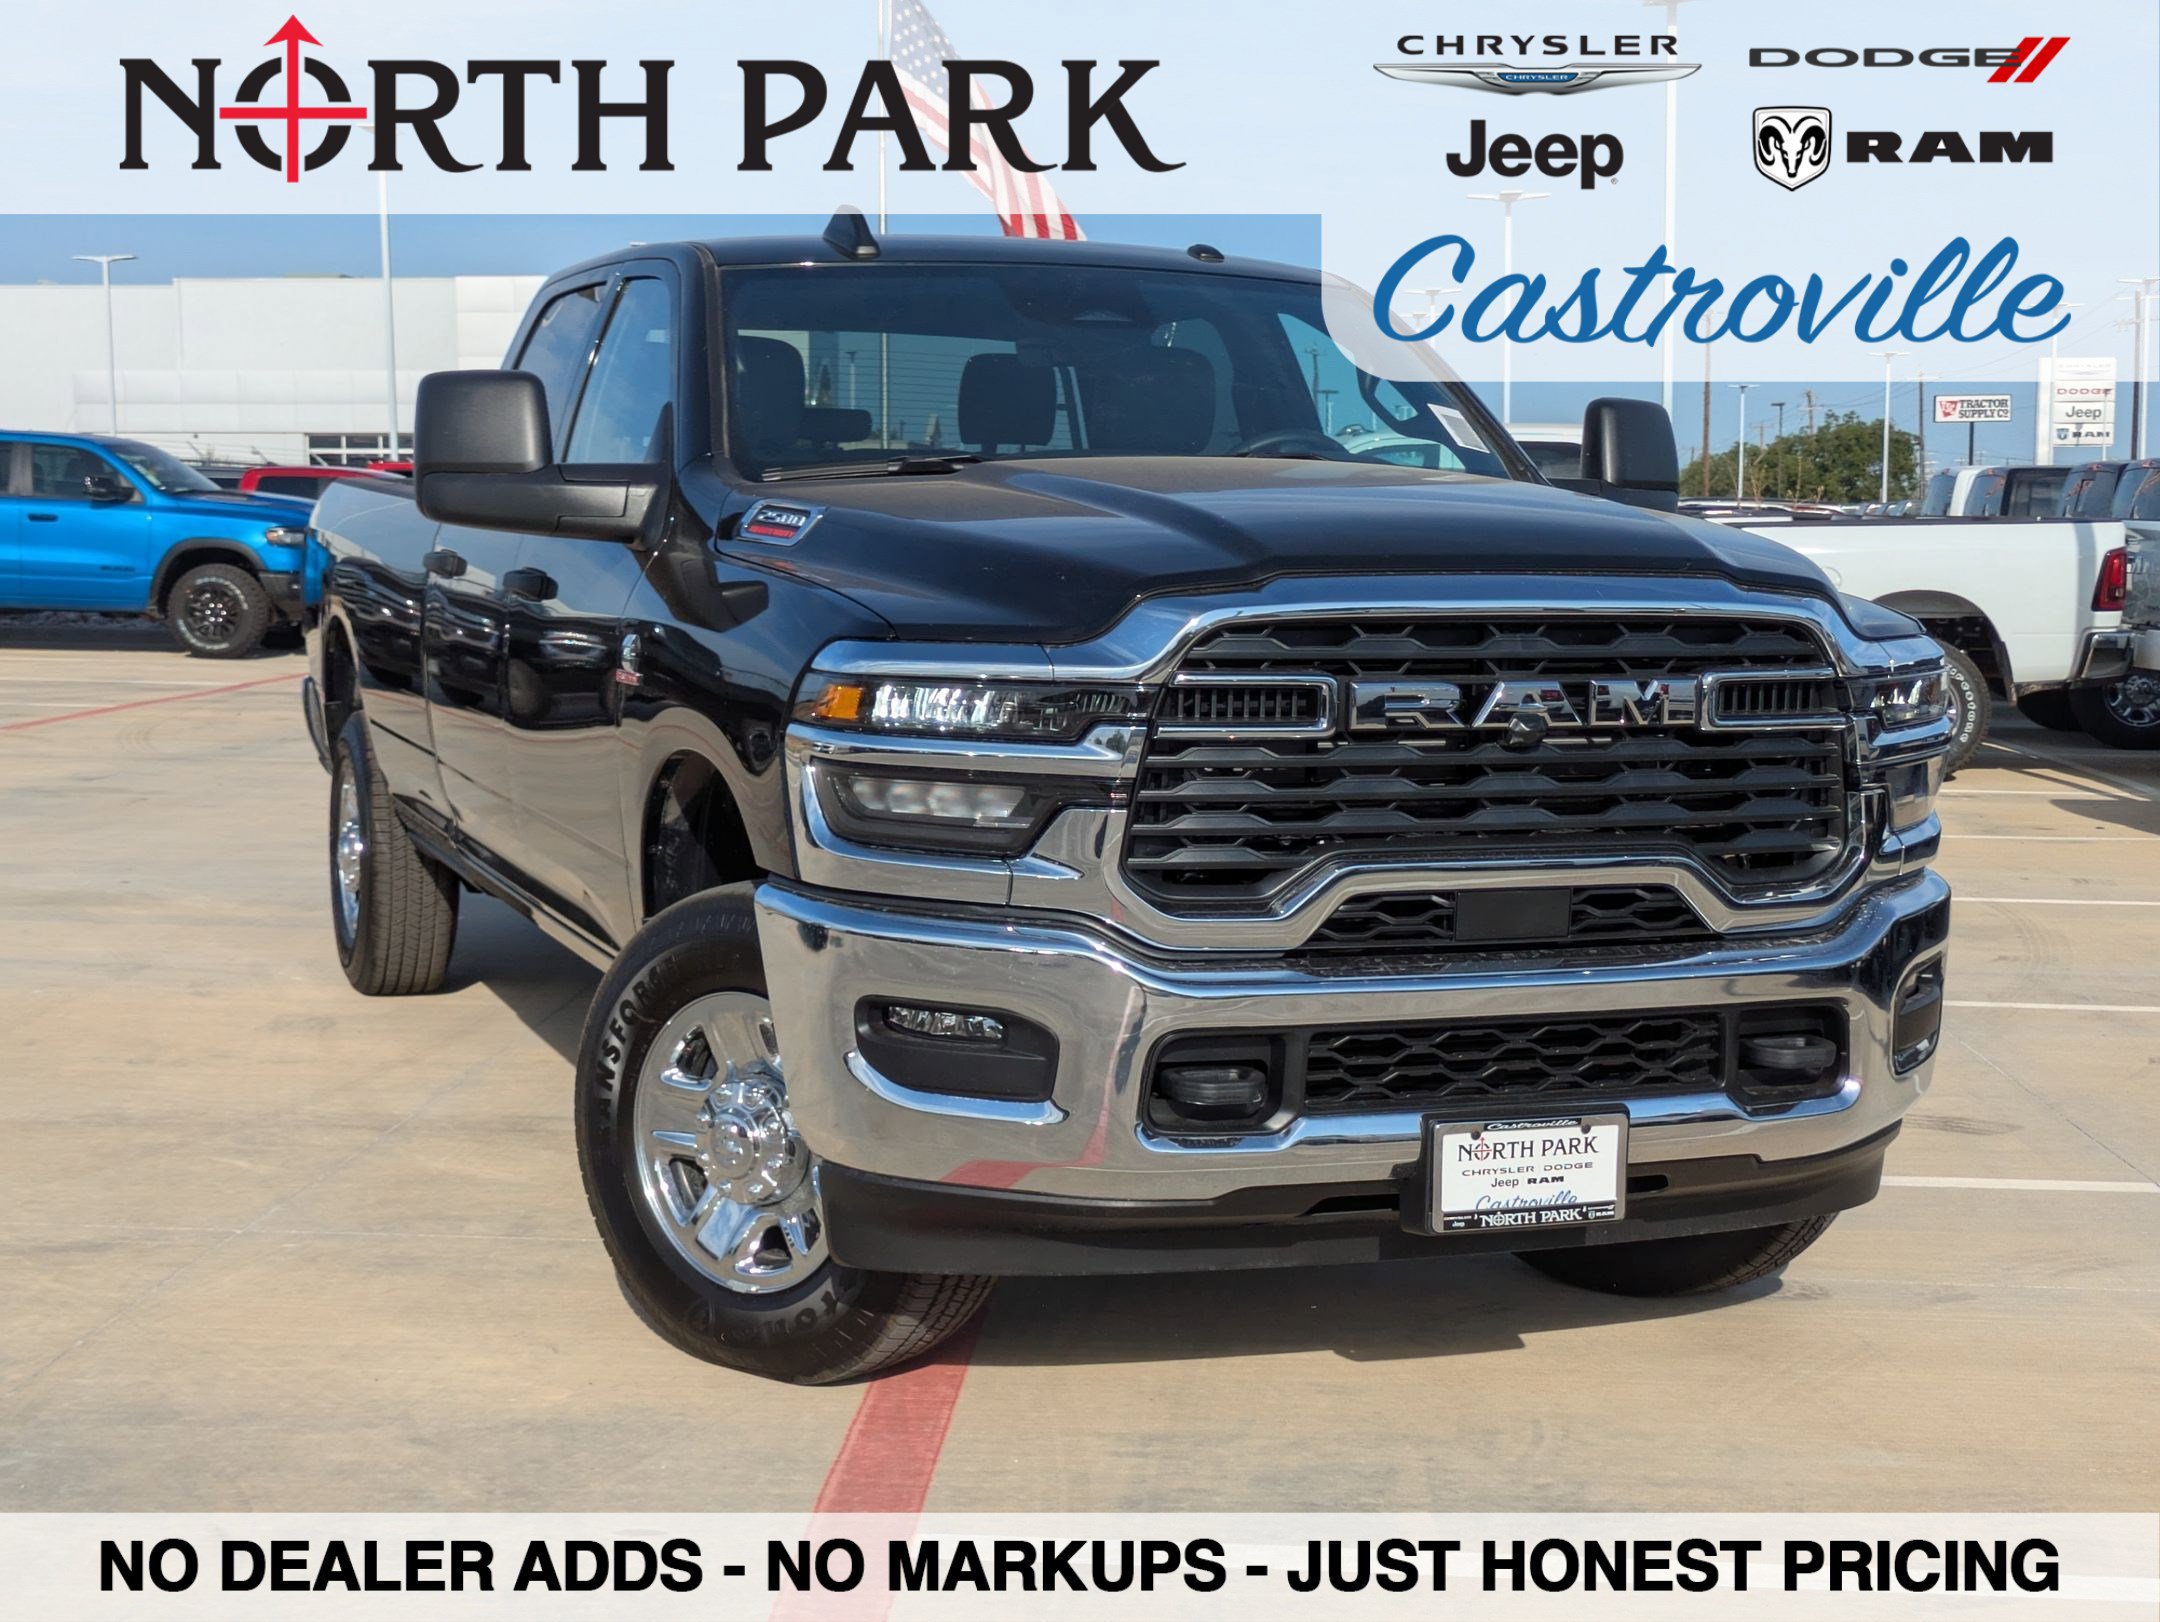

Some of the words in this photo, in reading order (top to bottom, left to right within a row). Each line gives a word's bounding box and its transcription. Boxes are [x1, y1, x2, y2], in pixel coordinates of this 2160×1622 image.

[1959, 399, 2008, 408] TRACTOR
[1958, 409, 1996, 418] SUPPLY
[2065, 406, 2102, 420] Jeep
[1350, 679, 1696, 730] RAM
[1487, 1119, 1579, 1131] Castroville
[1458, 1139, 1534, 1162] NORTH
[1541, 1136, 1599, 1157] PARK
[1462, 1165, 1535, 1176] CHRYSLER
[1543, 1161, 1594, 1172] DODGE
[1491, 1177, 1519, 1188] Jeep
[1527, 1175, 1564, 1185] RAM
[1479, 1211, 1537, 1228] NORTH
[1539, 1207, 1583, 1223] PARK
